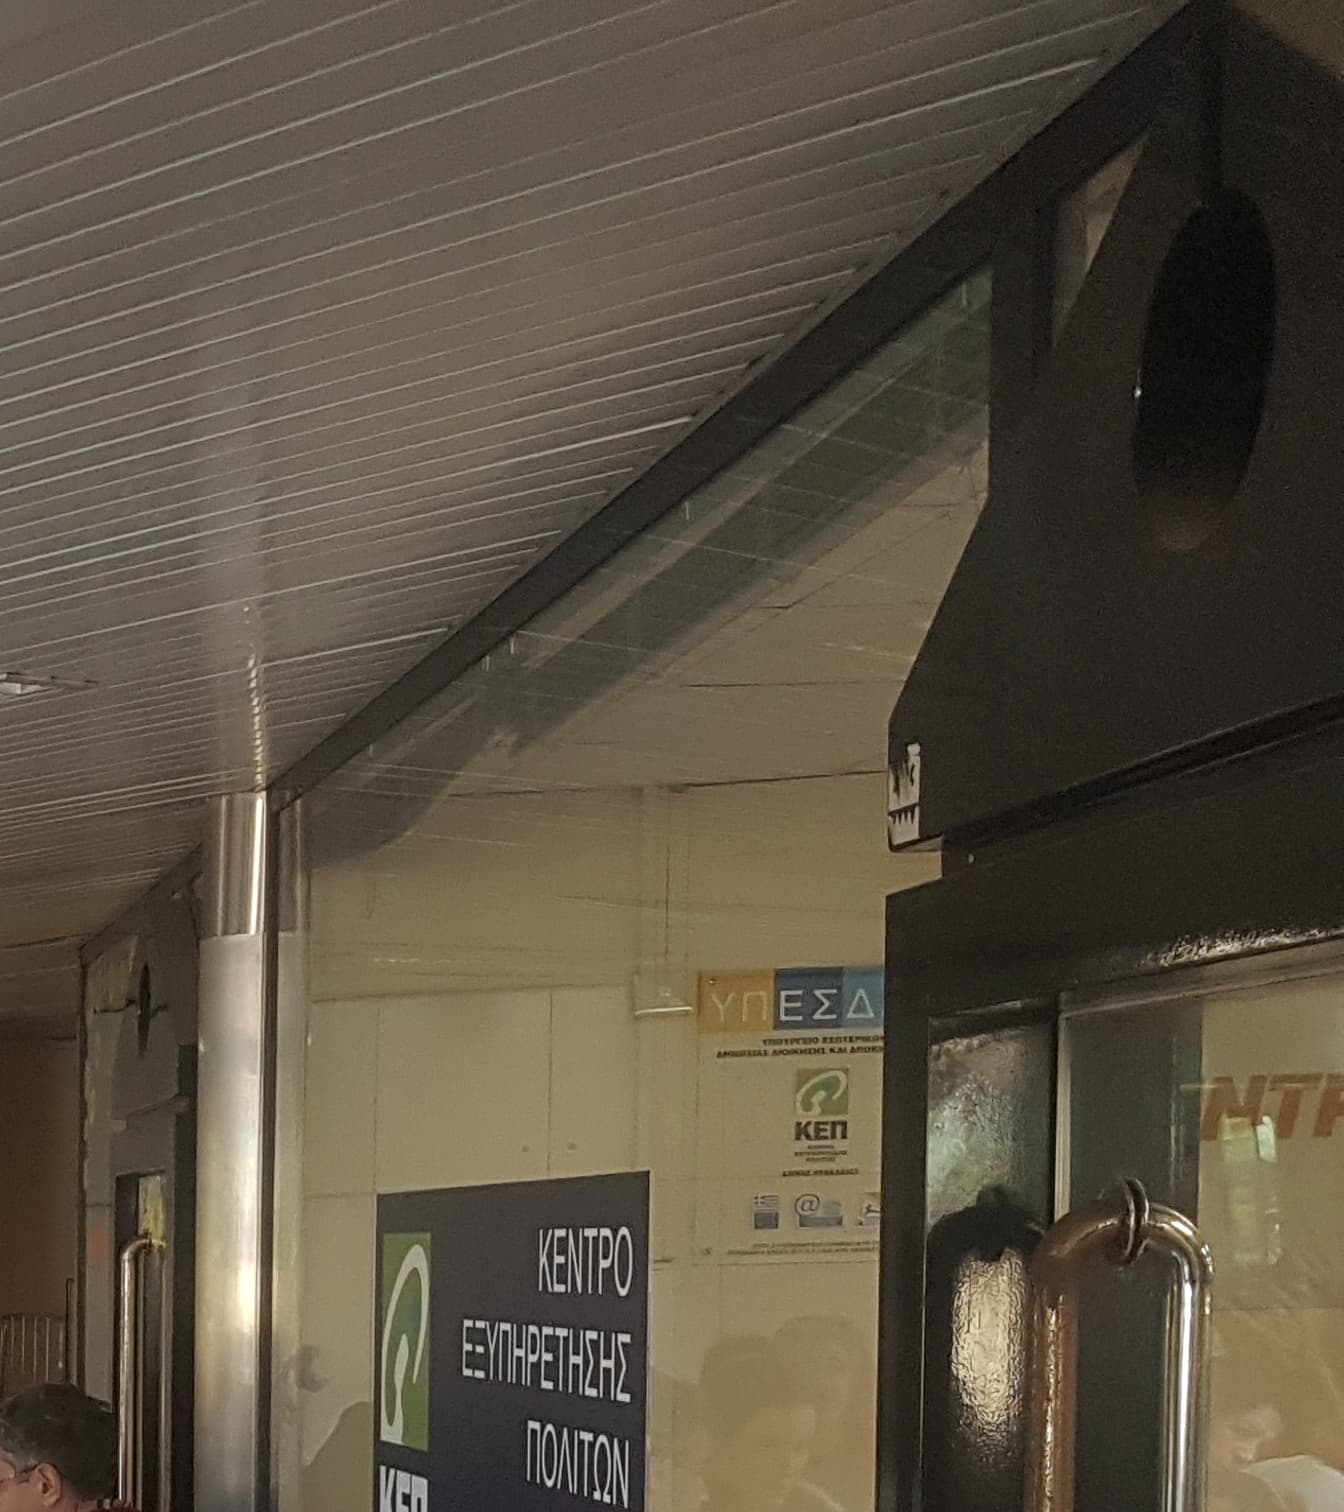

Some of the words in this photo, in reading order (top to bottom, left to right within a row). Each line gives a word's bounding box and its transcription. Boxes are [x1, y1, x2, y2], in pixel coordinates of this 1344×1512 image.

[794, 1120, 848, 1141] ΚΕΠ
[538, 1226, 633, 1297] ΚΕΝΤΡΟ
[461, 1318, 632, 1403] ΕΞΥΠΗΡΕΤΗΣΗΣ
[526, 1419, 630, 1509] ΠΟΛΙΤΩΝ
